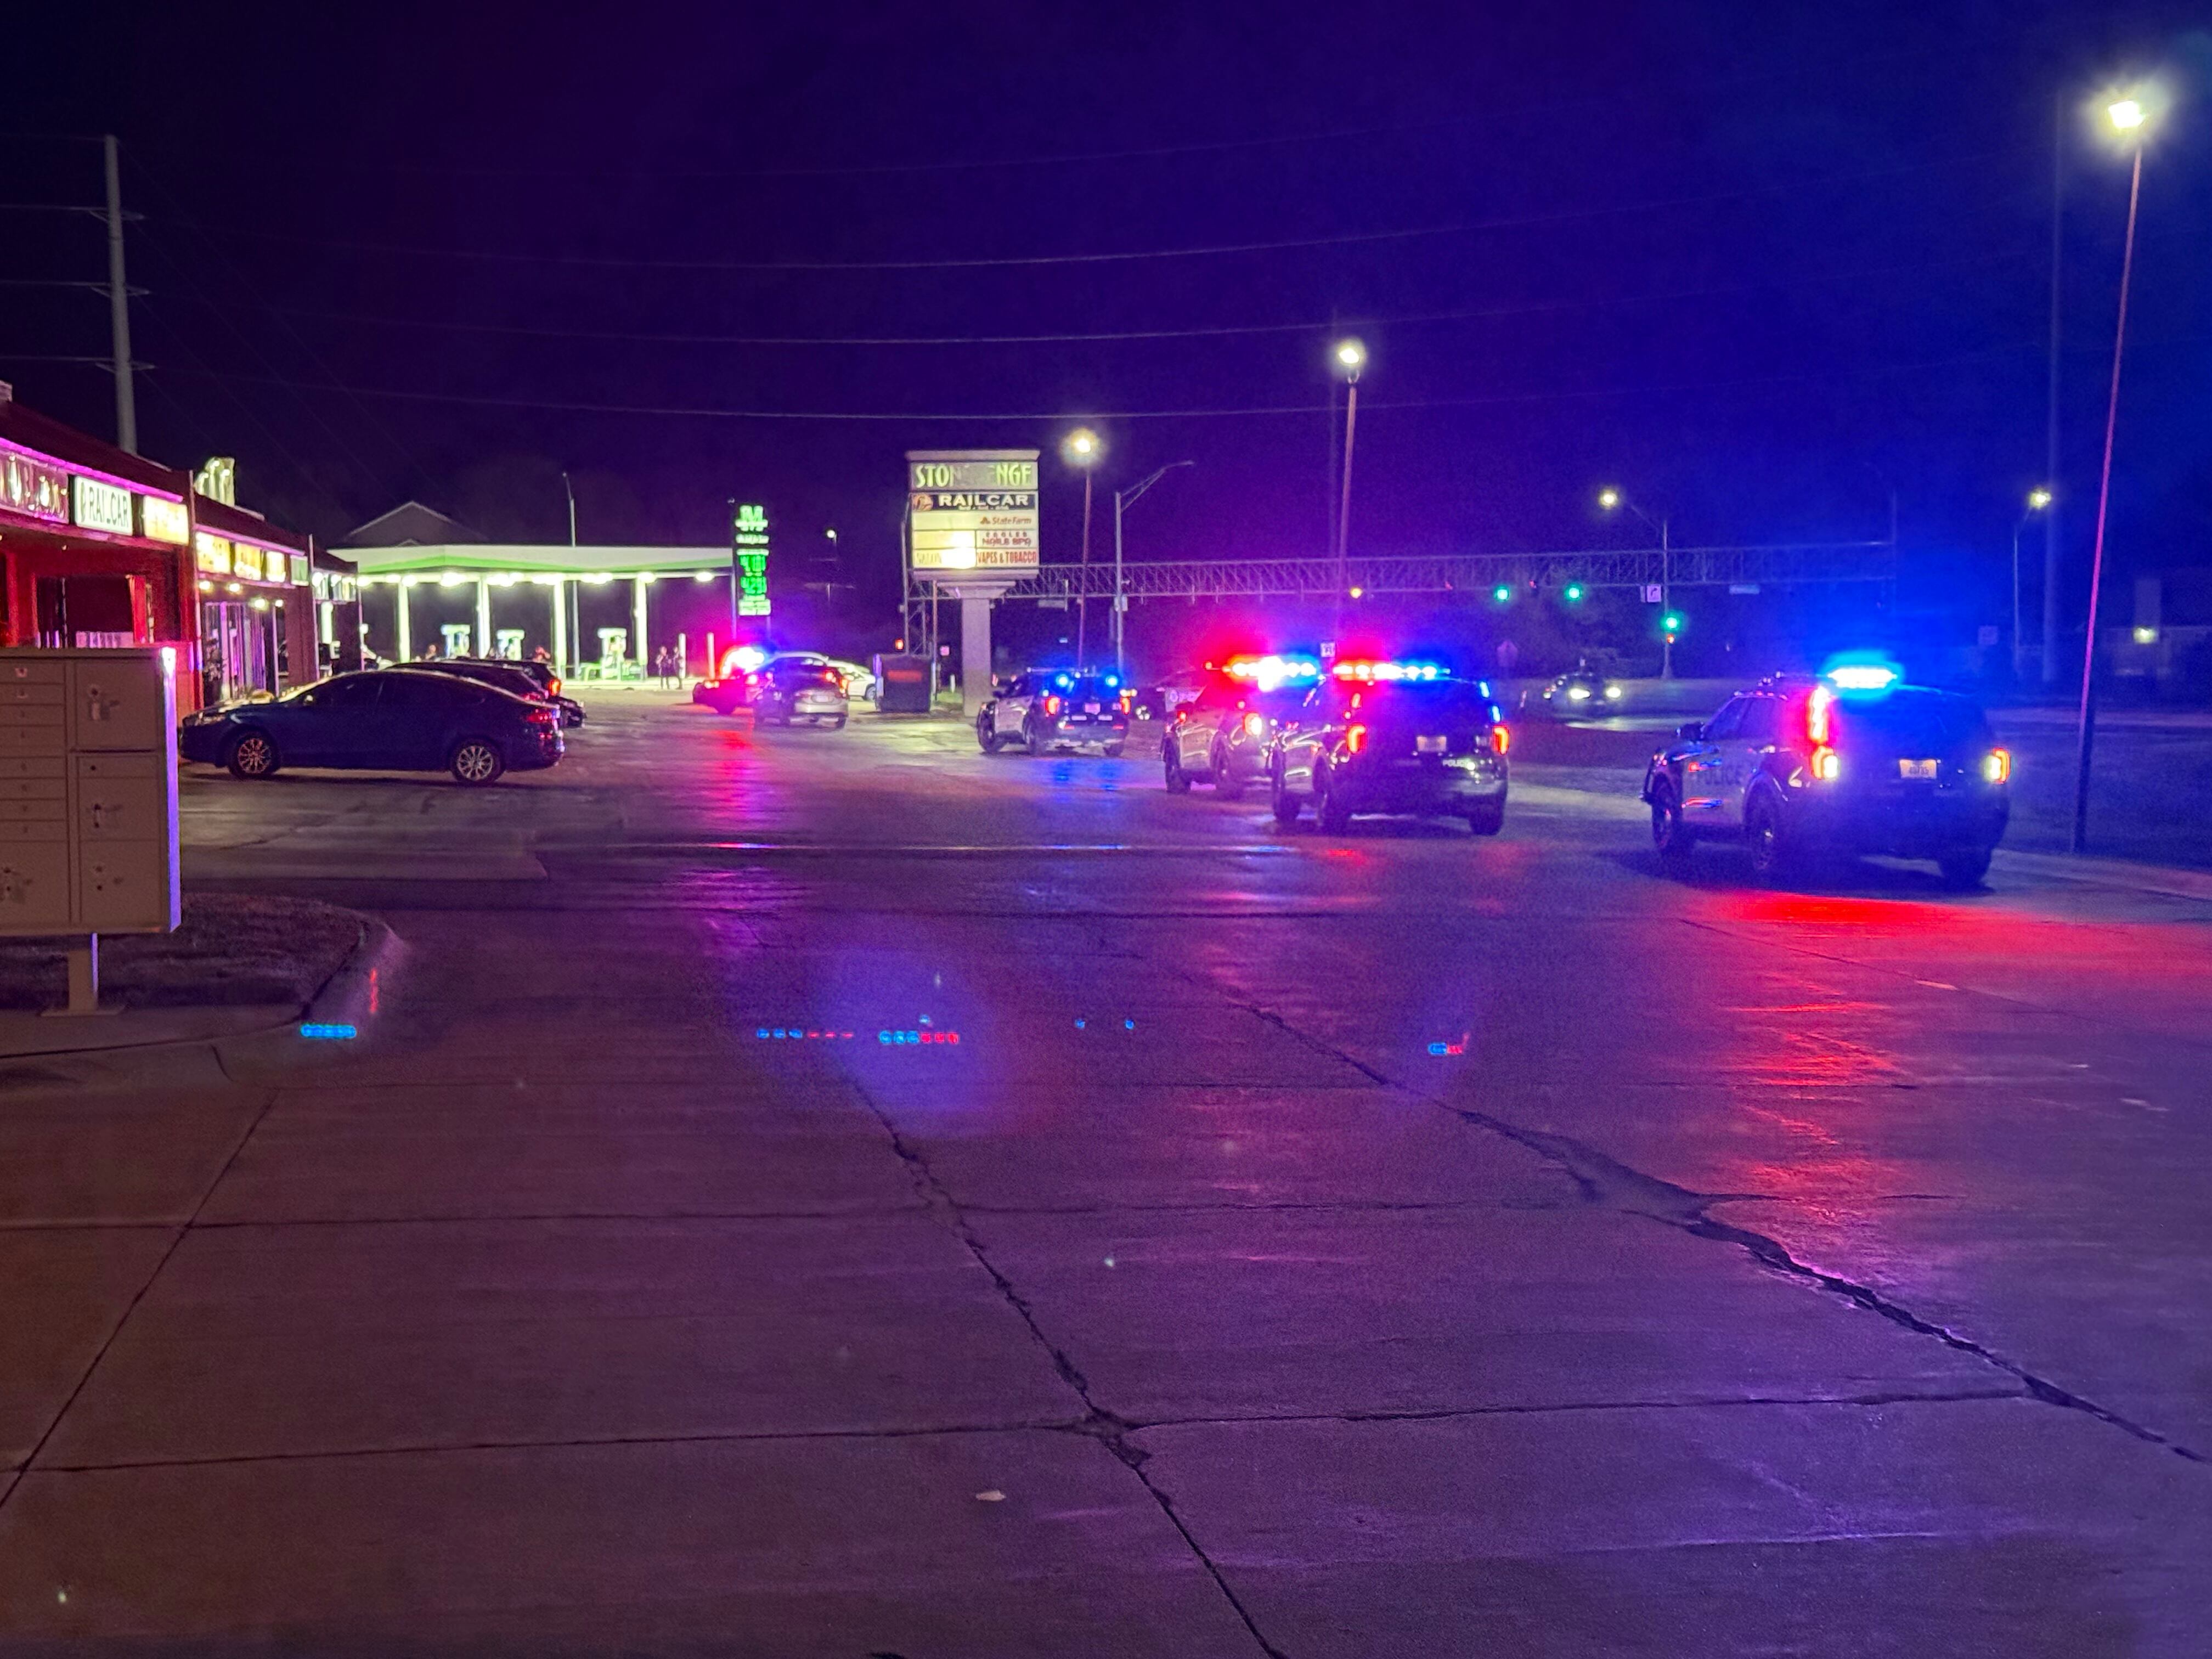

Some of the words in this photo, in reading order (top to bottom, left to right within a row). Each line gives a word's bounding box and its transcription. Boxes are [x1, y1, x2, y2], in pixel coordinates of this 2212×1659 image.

[939, 494, 1028, 506] RAILCAR
[977, 551, 998, 564] VAPES
[1005, 551, 1036, 564] TOBACCO
